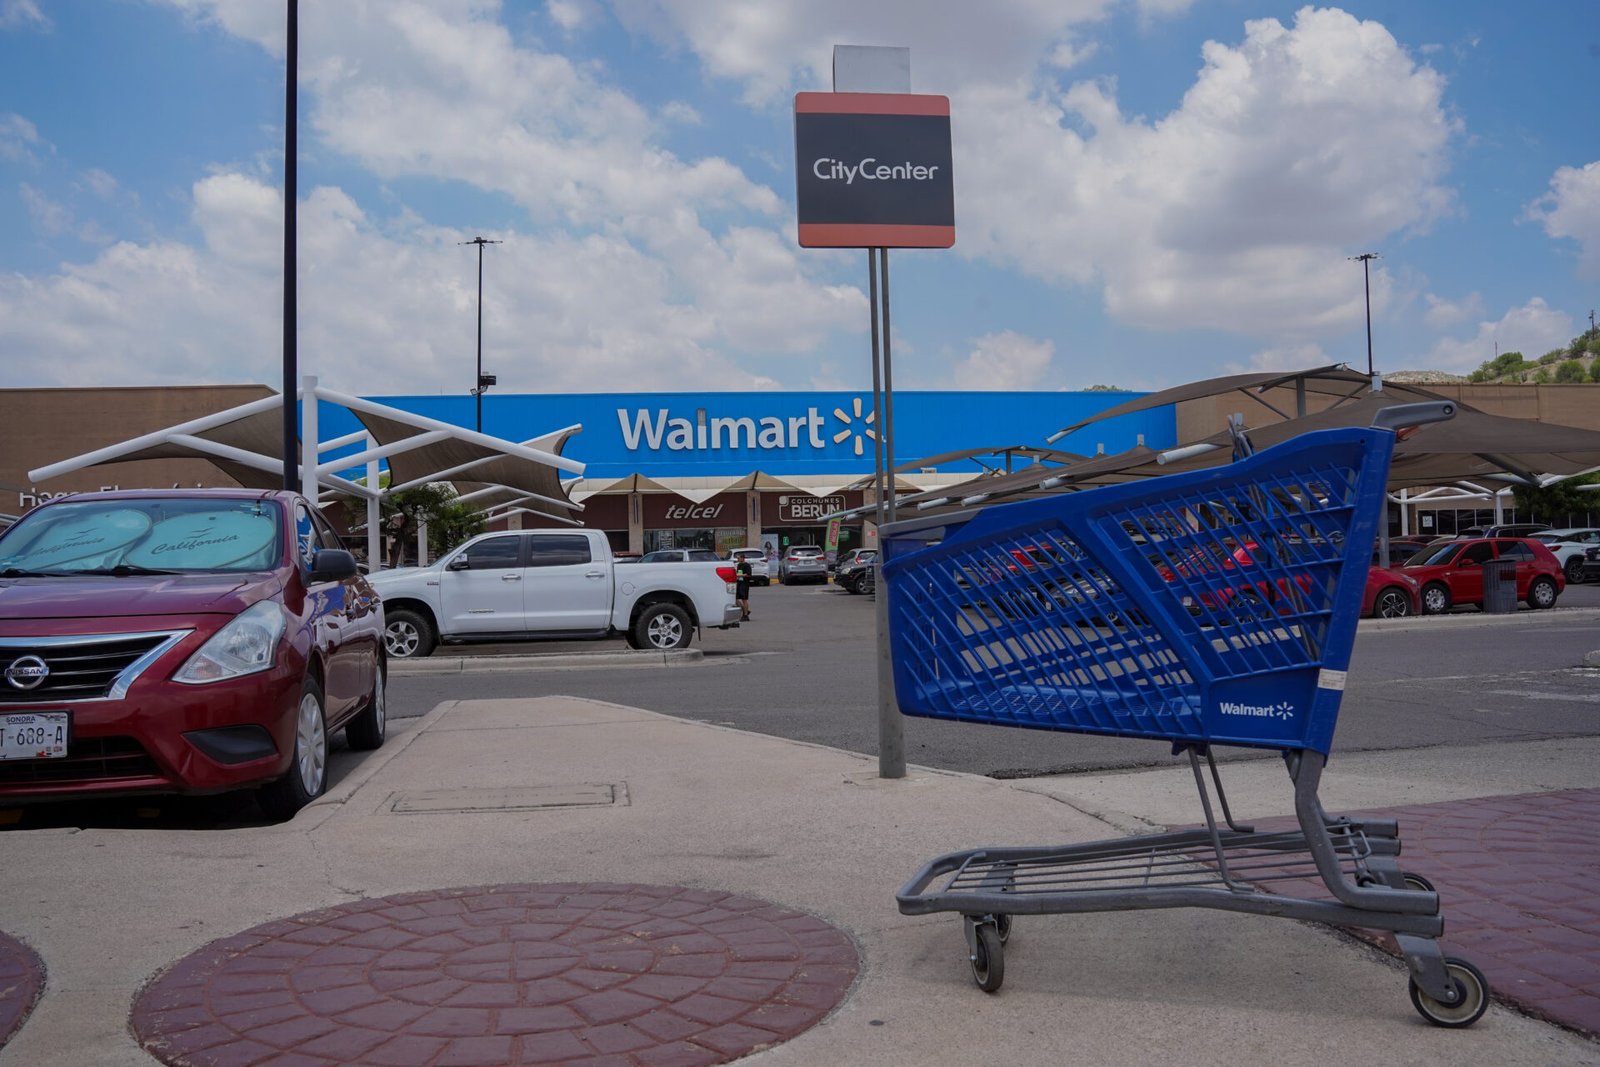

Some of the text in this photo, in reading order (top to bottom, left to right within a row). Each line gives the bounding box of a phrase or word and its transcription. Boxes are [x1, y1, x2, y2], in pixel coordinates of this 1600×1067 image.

[617, 407, 825, 450] Walmart
[664, 503, 724, 520] telcel
[150, 534, 241, 555] California
[1219, 702, 1275, 717] Walmart
